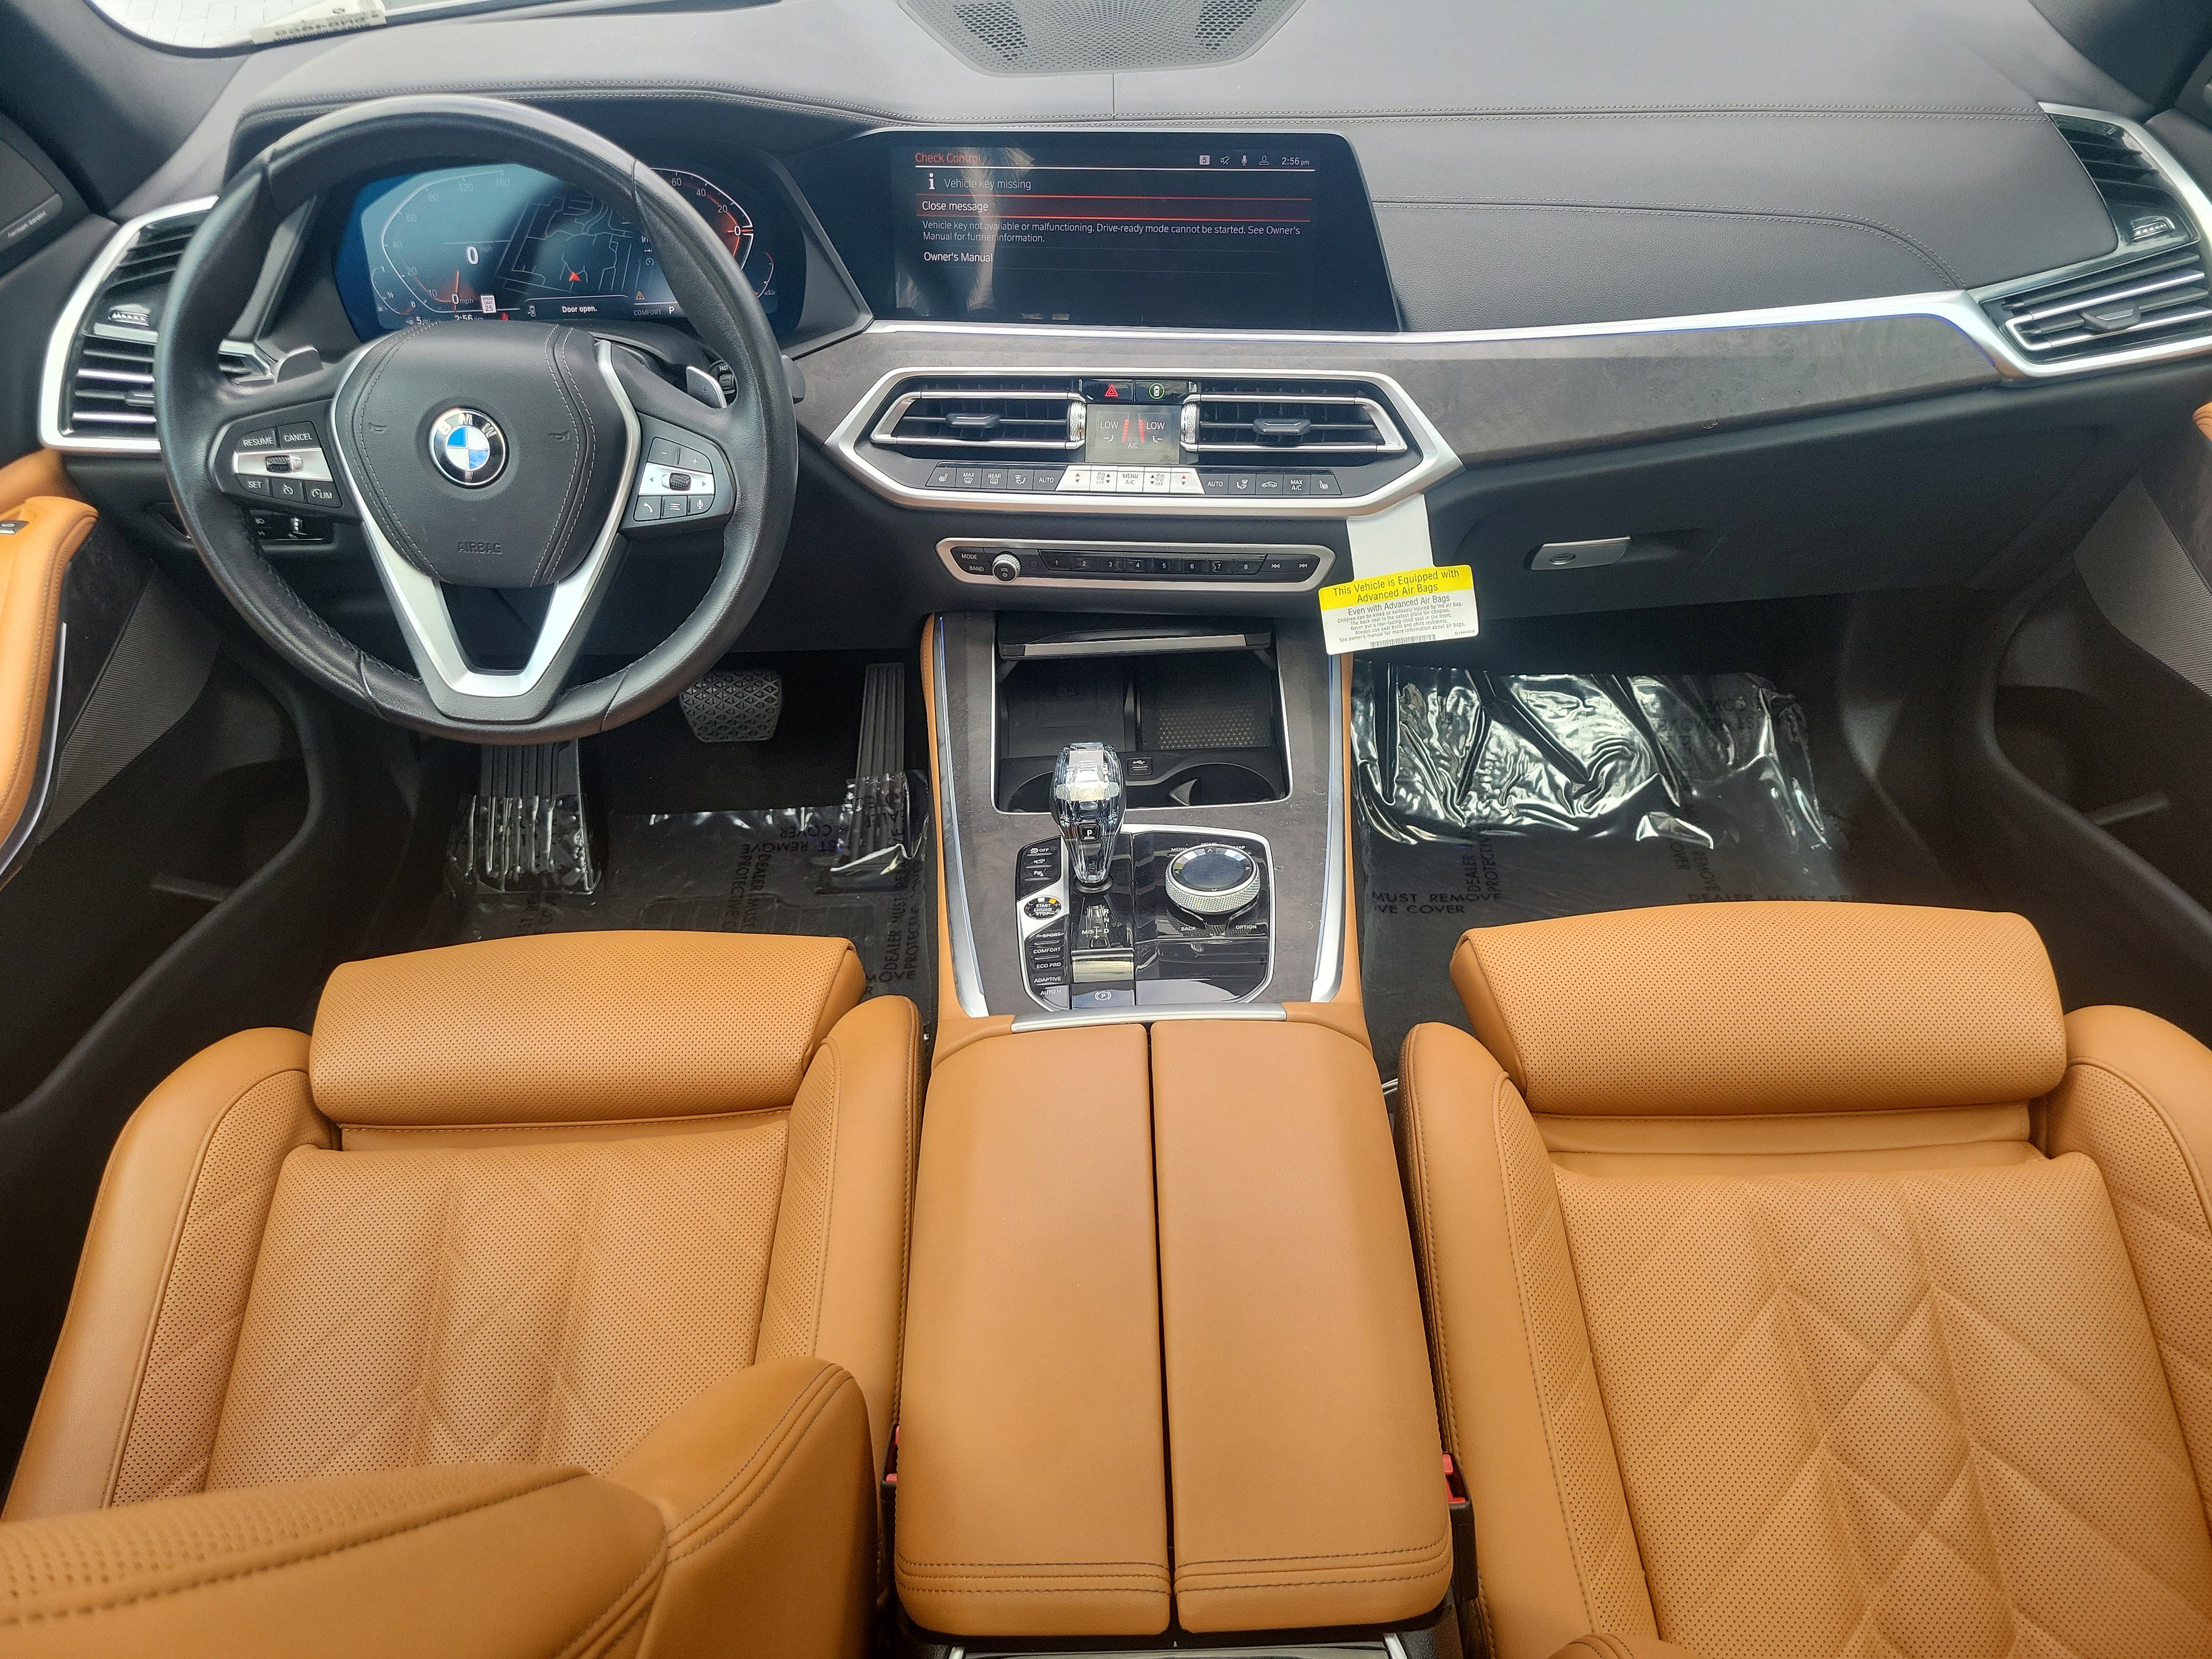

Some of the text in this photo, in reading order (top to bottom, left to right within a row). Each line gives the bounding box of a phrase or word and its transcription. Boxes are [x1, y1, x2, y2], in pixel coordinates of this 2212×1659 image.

[915, 153, 981, 163] Check Control
[1282, 157, 1300, 165] 2:56
[672, 178, 682, 187] 60
[944, 178, 1032, 190] Vehicle key missing
[428, 193, 439, 202] 80
[696, 188, 706, 197] 40
[718, 205, 727, 213] 20
[922, 201, 989, 213] Close message
[733, 225, 741, 236] 0
[922, 221, 952, 229] Vehicle
[953, 221, 968, 231] key
[984, 222, 1019, 230] available
[1032, 222, 1095, 234] malfunctioning.
[1097, 223, 1144, 235] Drive-ready
[1146, 224, 1169, 233] mode
[1171, 225, 1200, 234] cannot
[1201, 225, 1212, 234] be
[1214, 225, 1246, 234] started.
[1248, 226, 1264, 235] See
[1266, 226, 1300, 235] Owner's
[923, 232, 1045, 242] Manual for further information.
[466, 246, 479, 265] 0
[924, 251, 993, 262] Owner's Manual
[428, 289, 438, 297] 10
[452, 294, 460, 305] 0
[438, 412, 498, 438] BMW
[1100, 421, 1119, 429] LOW
[1146, 421, 1165, 430] LOW
[243, 437, 274, 447] RESUME
[284, 433, 313, 443] CANCEL
[458, 541, 503, 554] AIRBAG
[1333, 569, 1459, 596] This Vehicle is Equipped with
[1357, 583, 1438, 603] Advanced Air Bags
[1348, 595, 1450, 616] Even with Advanced Air Bags
[1377, 618, 1401, 627] rear-facing
[742, 842, 809, 853] REMOVE
[1462, 855, 1481, 892] DEALER
[726, 855, 753, 916] PROTECTIVE
[741, 854, 771, 928] DEALER MUST
[1372, 891, 1503, 902] MUST REMOVE
[1406, 904, 1465, 913] COVER
[883, 897, 907, 970] DEALER MUST
